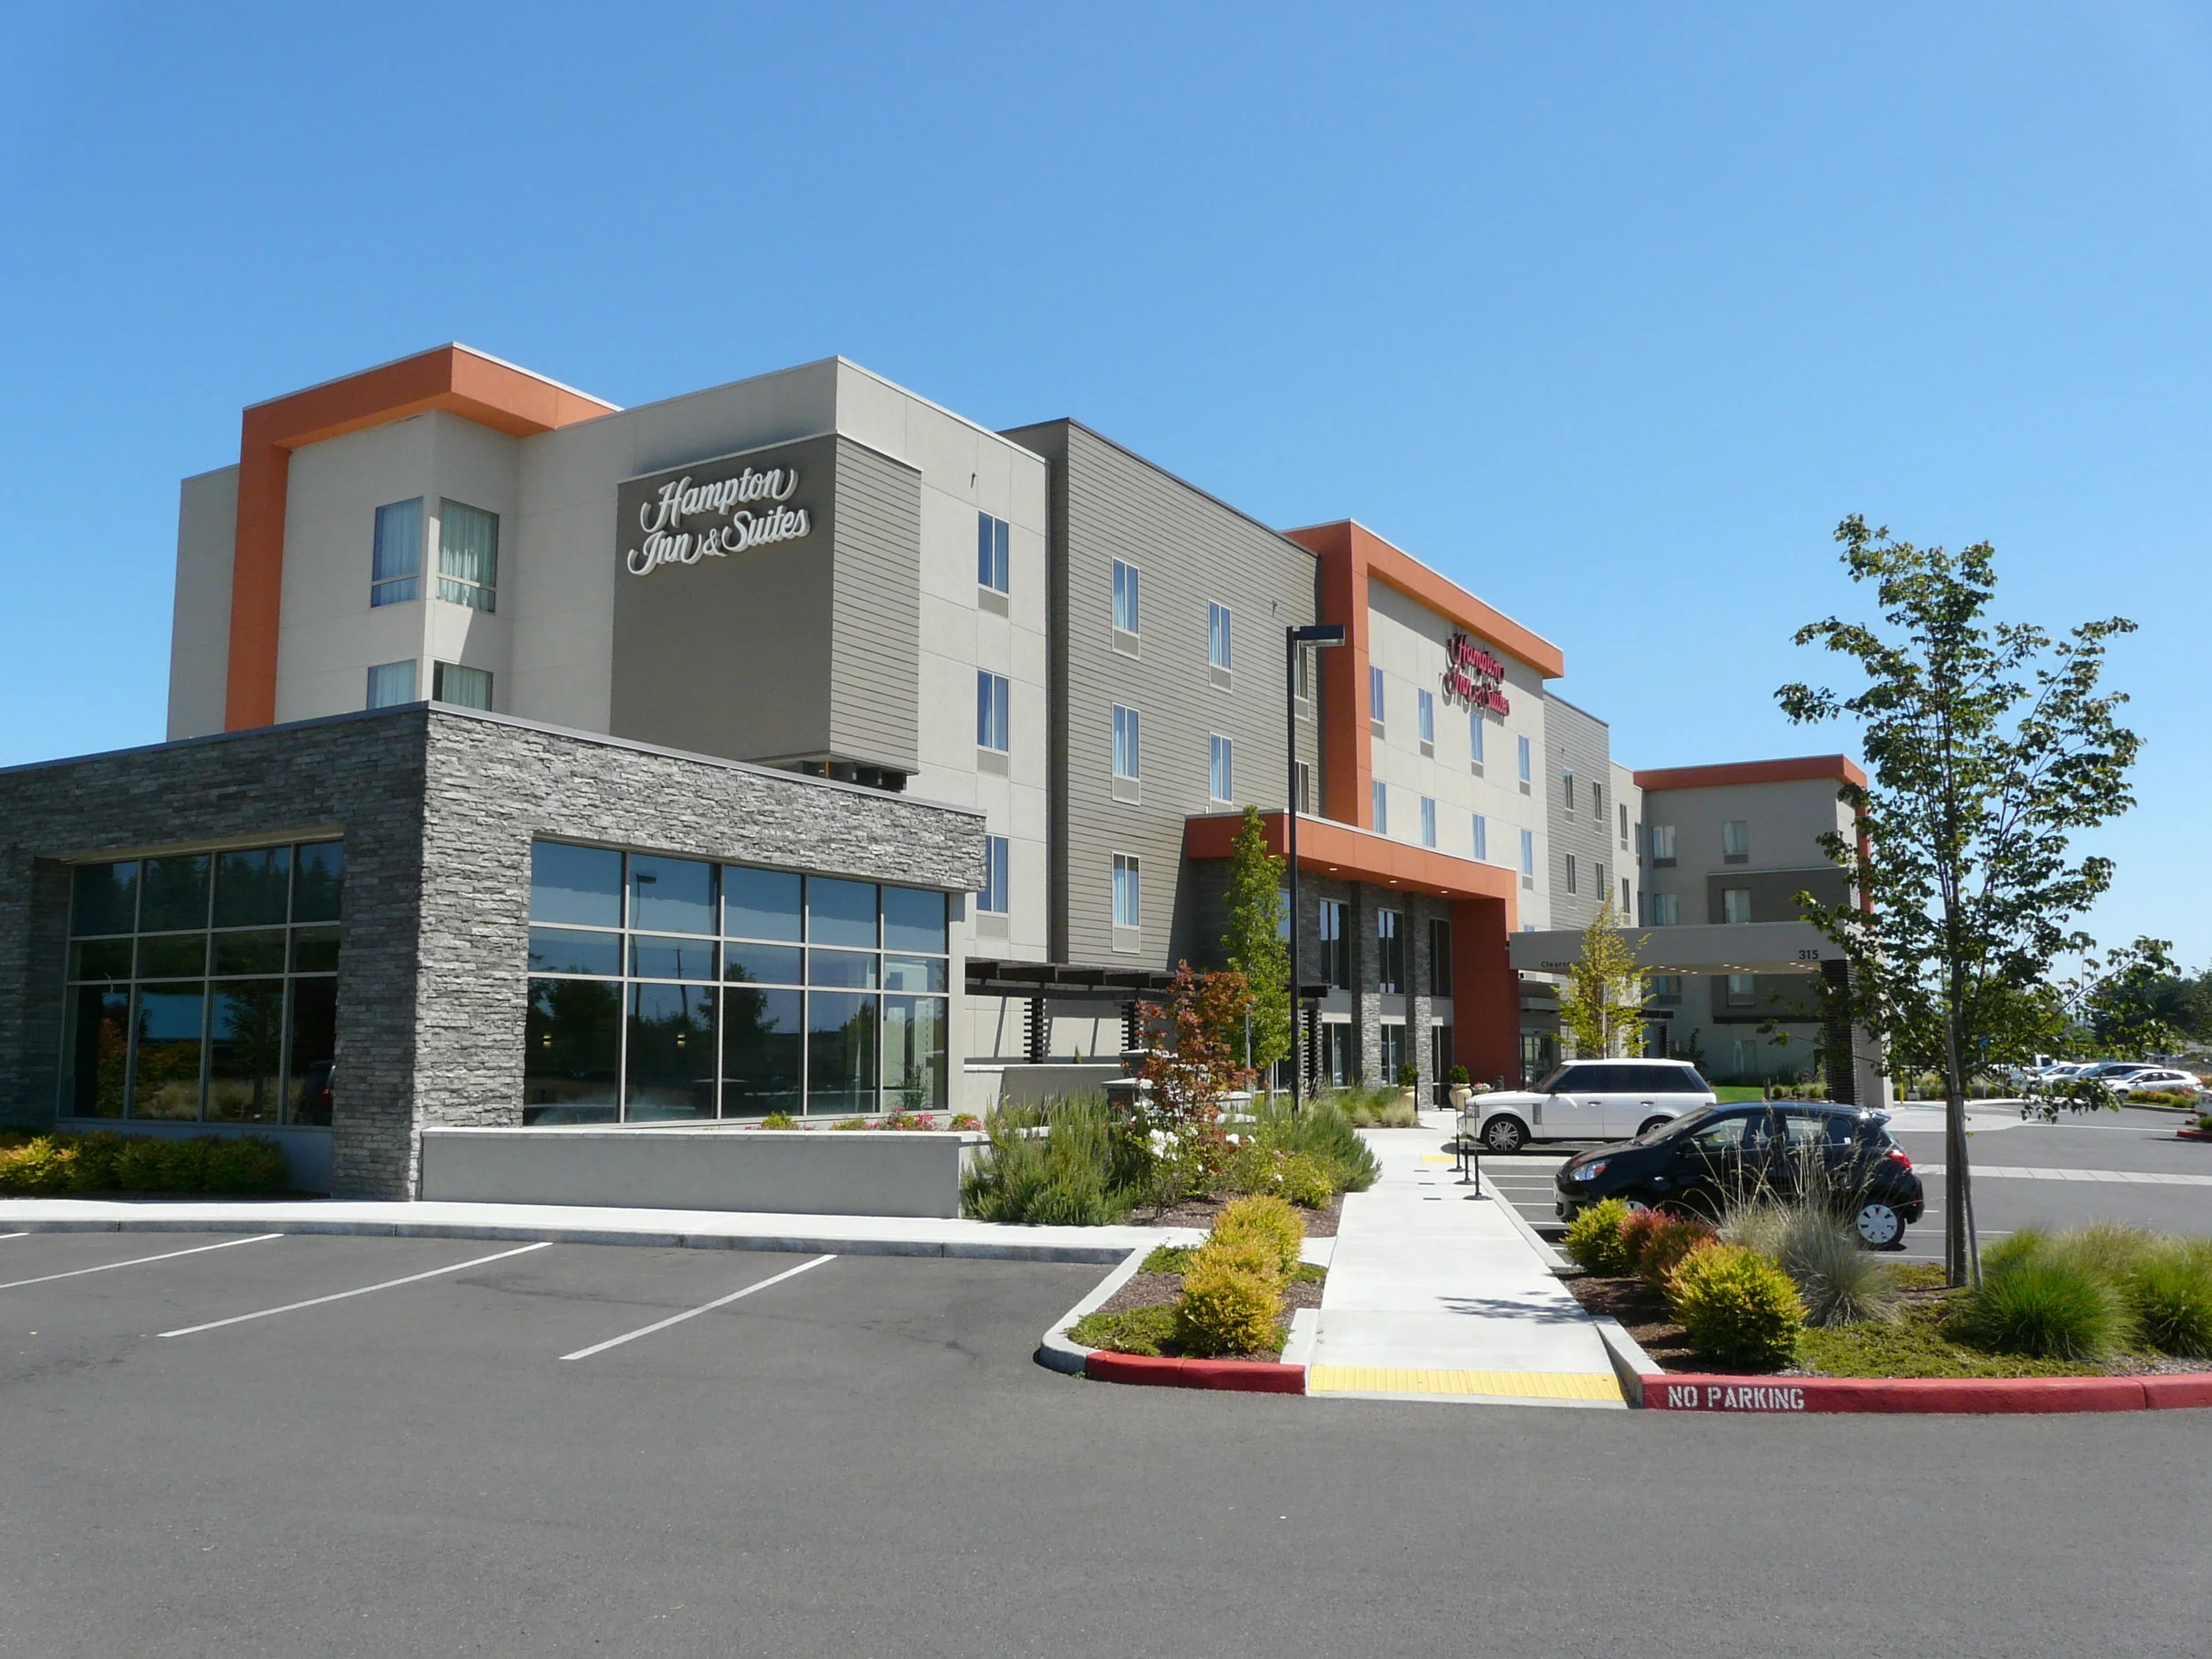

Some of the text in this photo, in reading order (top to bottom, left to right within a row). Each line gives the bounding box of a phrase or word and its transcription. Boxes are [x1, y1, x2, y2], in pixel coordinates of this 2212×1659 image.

[640, 467, 798, 534] Hampton
[626, 505, 810, 576] Inn & Suites
[1448, 634, 1505, 685] Hampton
[1482, 682, 1510, 717] Suites
[1798, 949, 1820, 960] 315
[1668, 1386, 1805, 1409] NO PARKING
